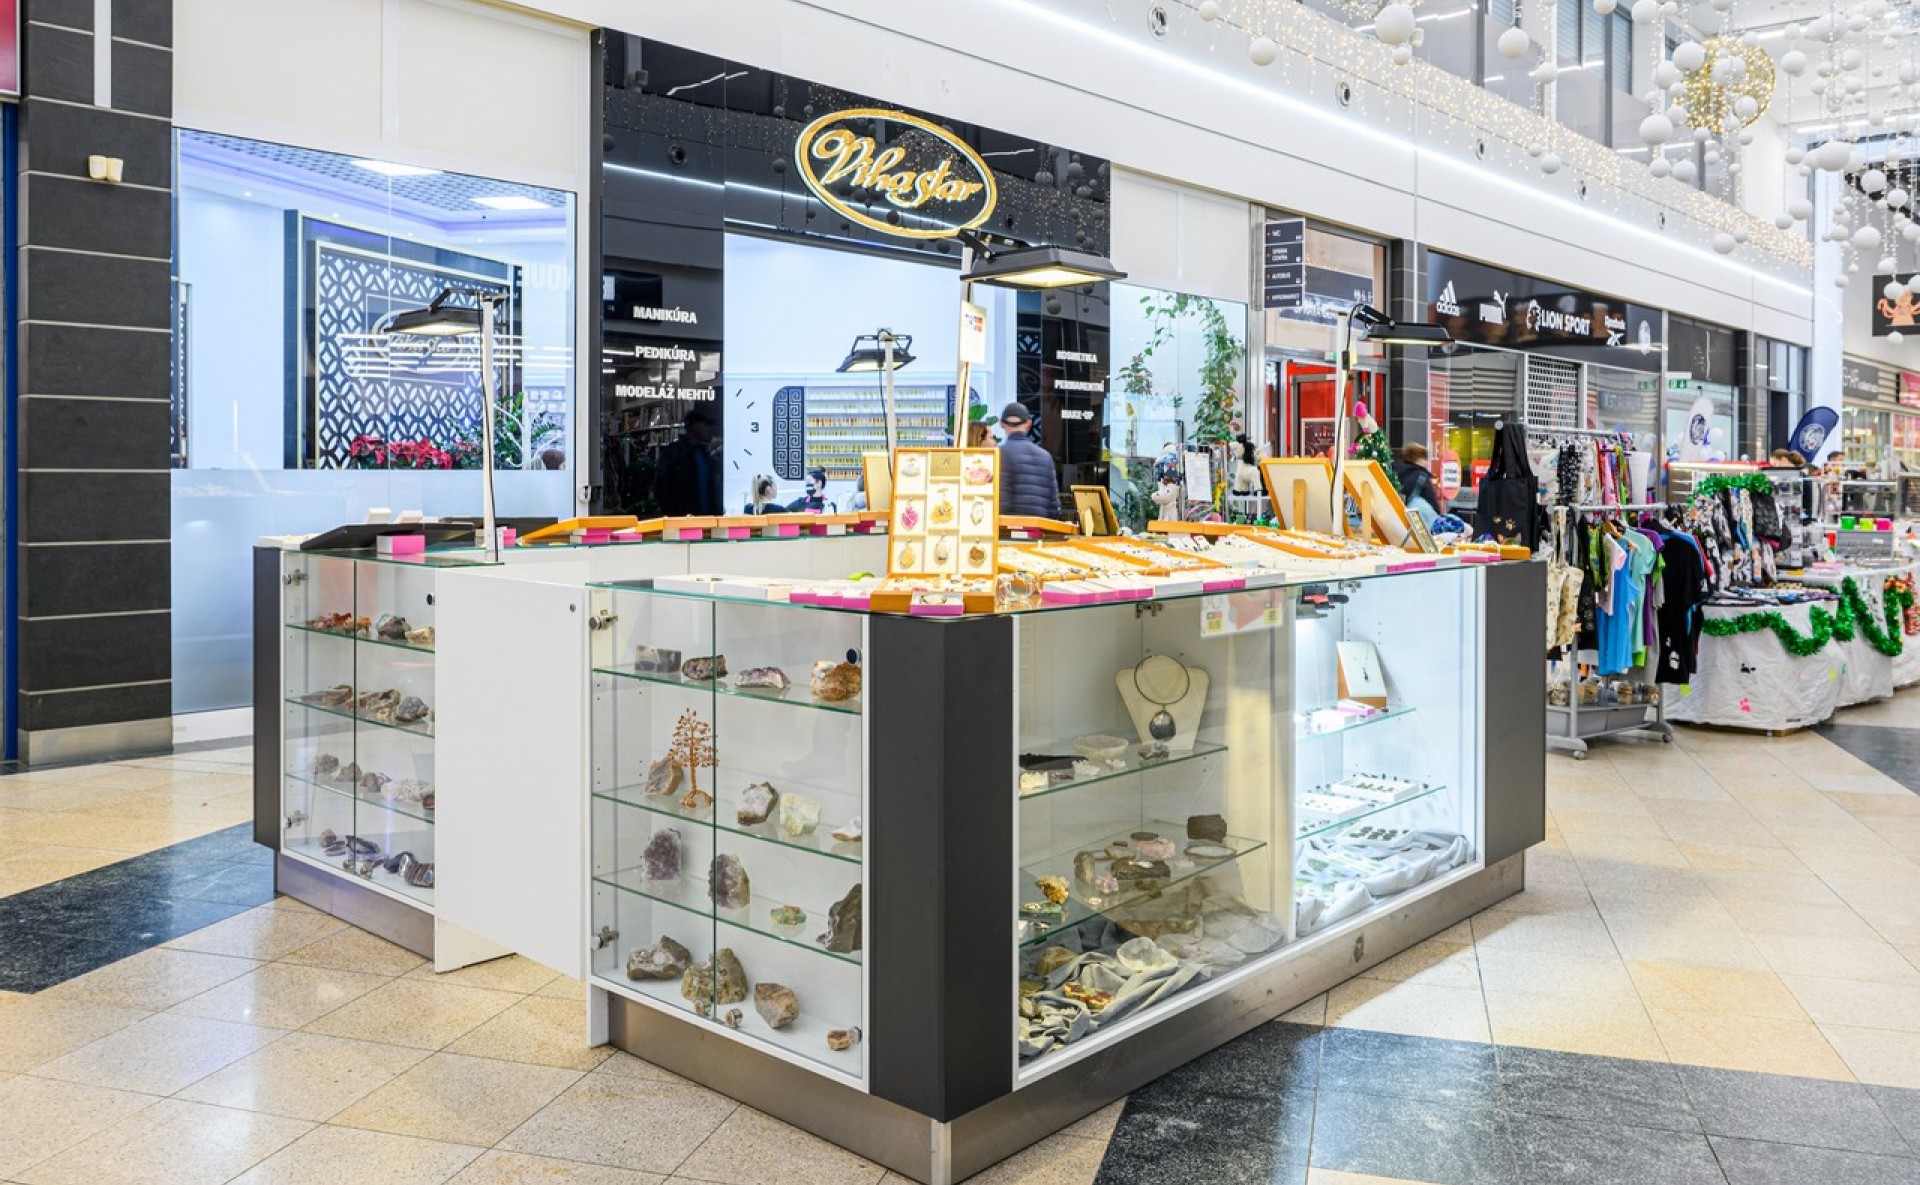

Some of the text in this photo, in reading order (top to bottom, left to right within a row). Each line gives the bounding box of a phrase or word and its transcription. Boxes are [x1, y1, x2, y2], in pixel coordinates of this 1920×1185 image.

[1271, 229, 1281, 237] WC
[633, 305, 698, 324] MANIKÚRA
[1436, 301, 1460, 317] adidas
[1479, 303, 1503, 325] PUMA
[1541, 309, 1590, 336] LION SPORT
[635, 344, 697, 362] PEDIKÚRA
[615, 382, 715, 401] MODELÁŽ NEHTŮ
[750, 421, 760, 433] 3
